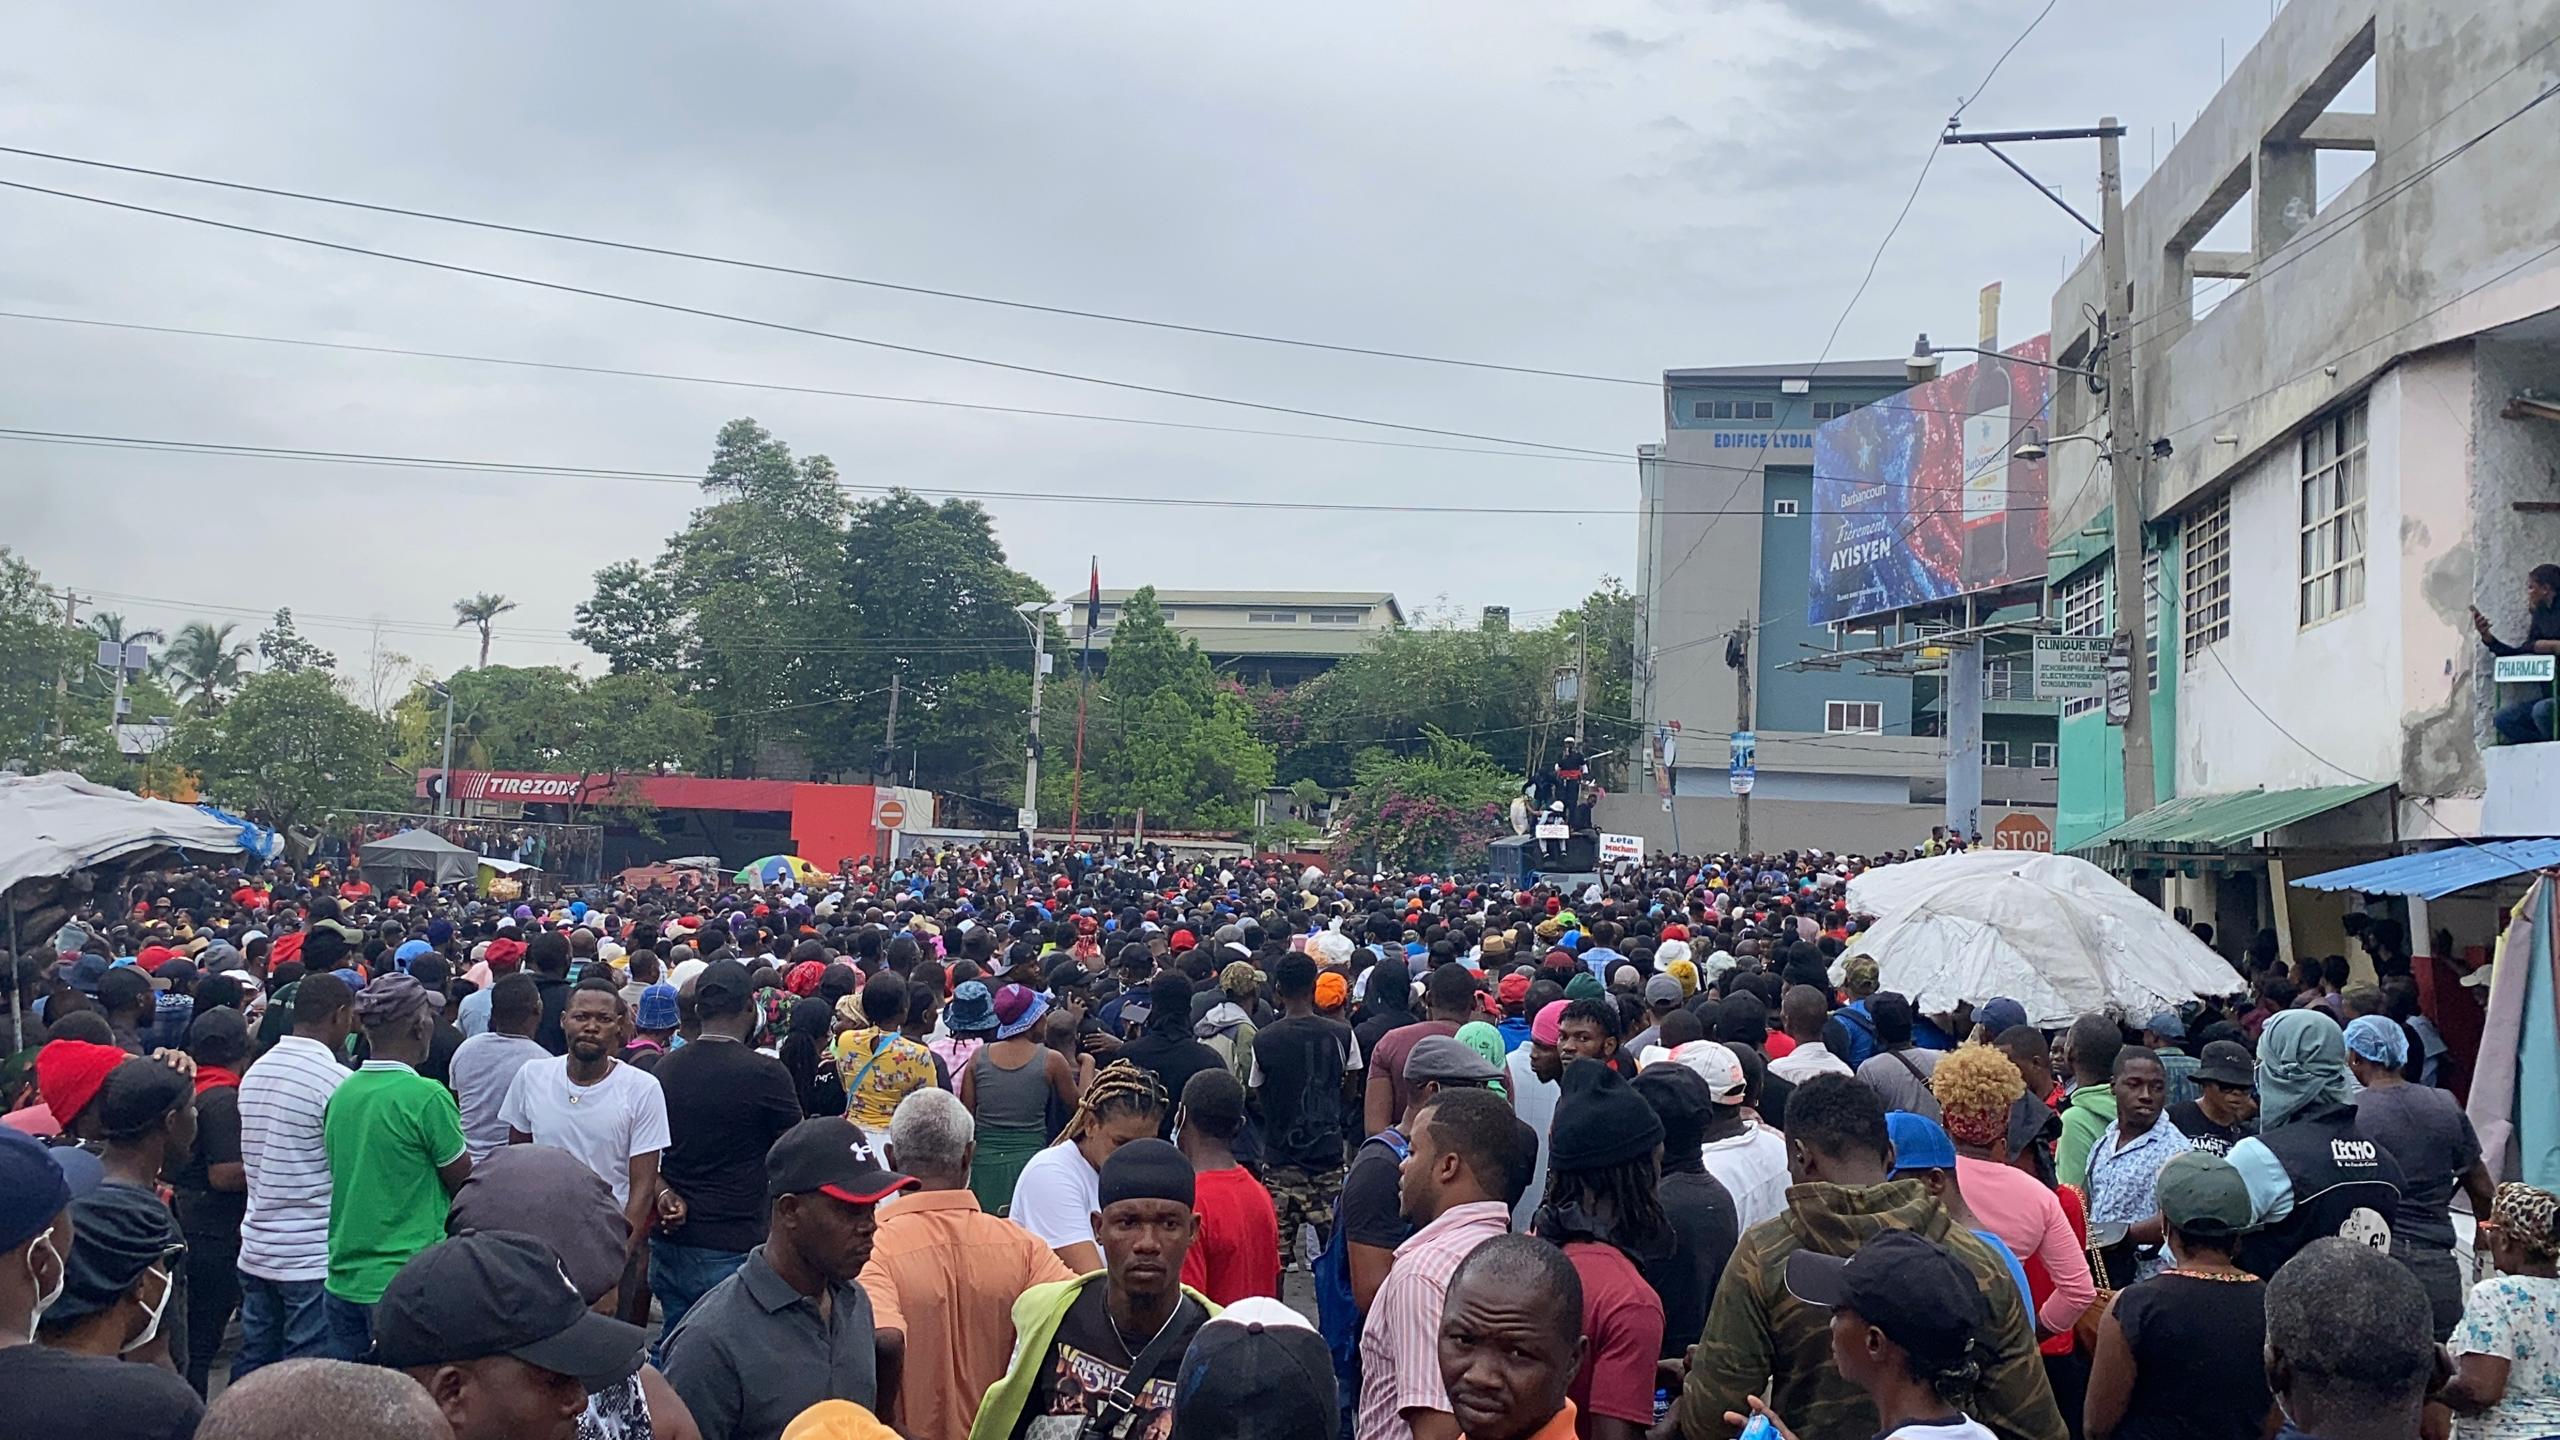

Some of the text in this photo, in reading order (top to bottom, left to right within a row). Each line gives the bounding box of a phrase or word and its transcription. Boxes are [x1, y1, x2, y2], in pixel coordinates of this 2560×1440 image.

[1714, 433, 1813, 448] EDIFICE LYDIA
[1841, 482, 1887, 508] Barbancourt
[1830, 537, 1891, 572] AYISYEN
[2037, 639, 2086, 651] CLINIQUE
[2498, 660, 2551, 677] PHARMACIE
[1996, 830, 2049, 851] STOP
